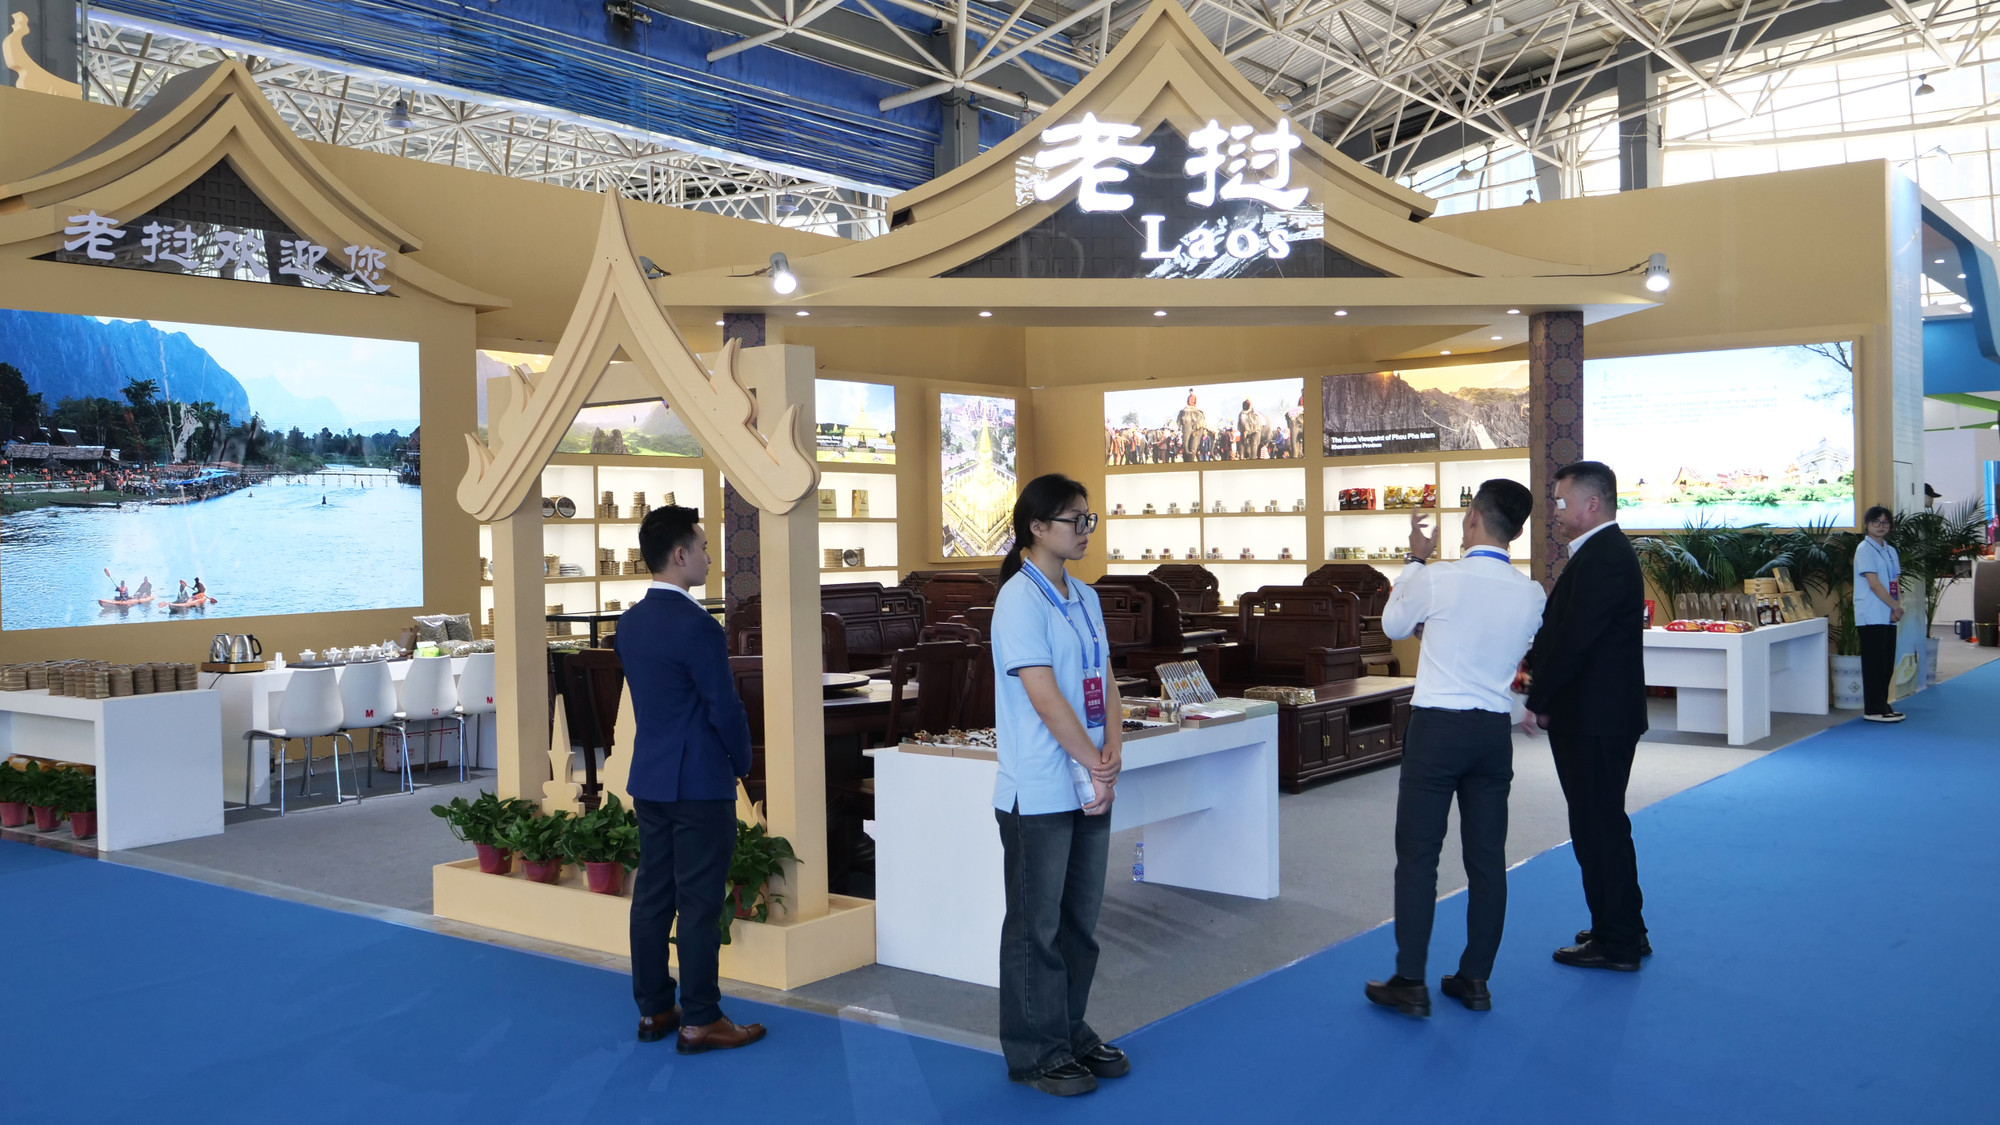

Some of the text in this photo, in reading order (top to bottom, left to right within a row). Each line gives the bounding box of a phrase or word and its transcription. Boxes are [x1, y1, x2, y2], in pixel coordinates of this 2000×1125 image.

[1033, 111, 1310, 213] 老挝
[1139, 214, 1291, 260] Laos
[63, 209, 392, 294] 老挝欢迎您
[1358, 435, 1385, 443] Viewpoint
[365, 709, 374, 718] M
[486, 696, 494, 704] M
